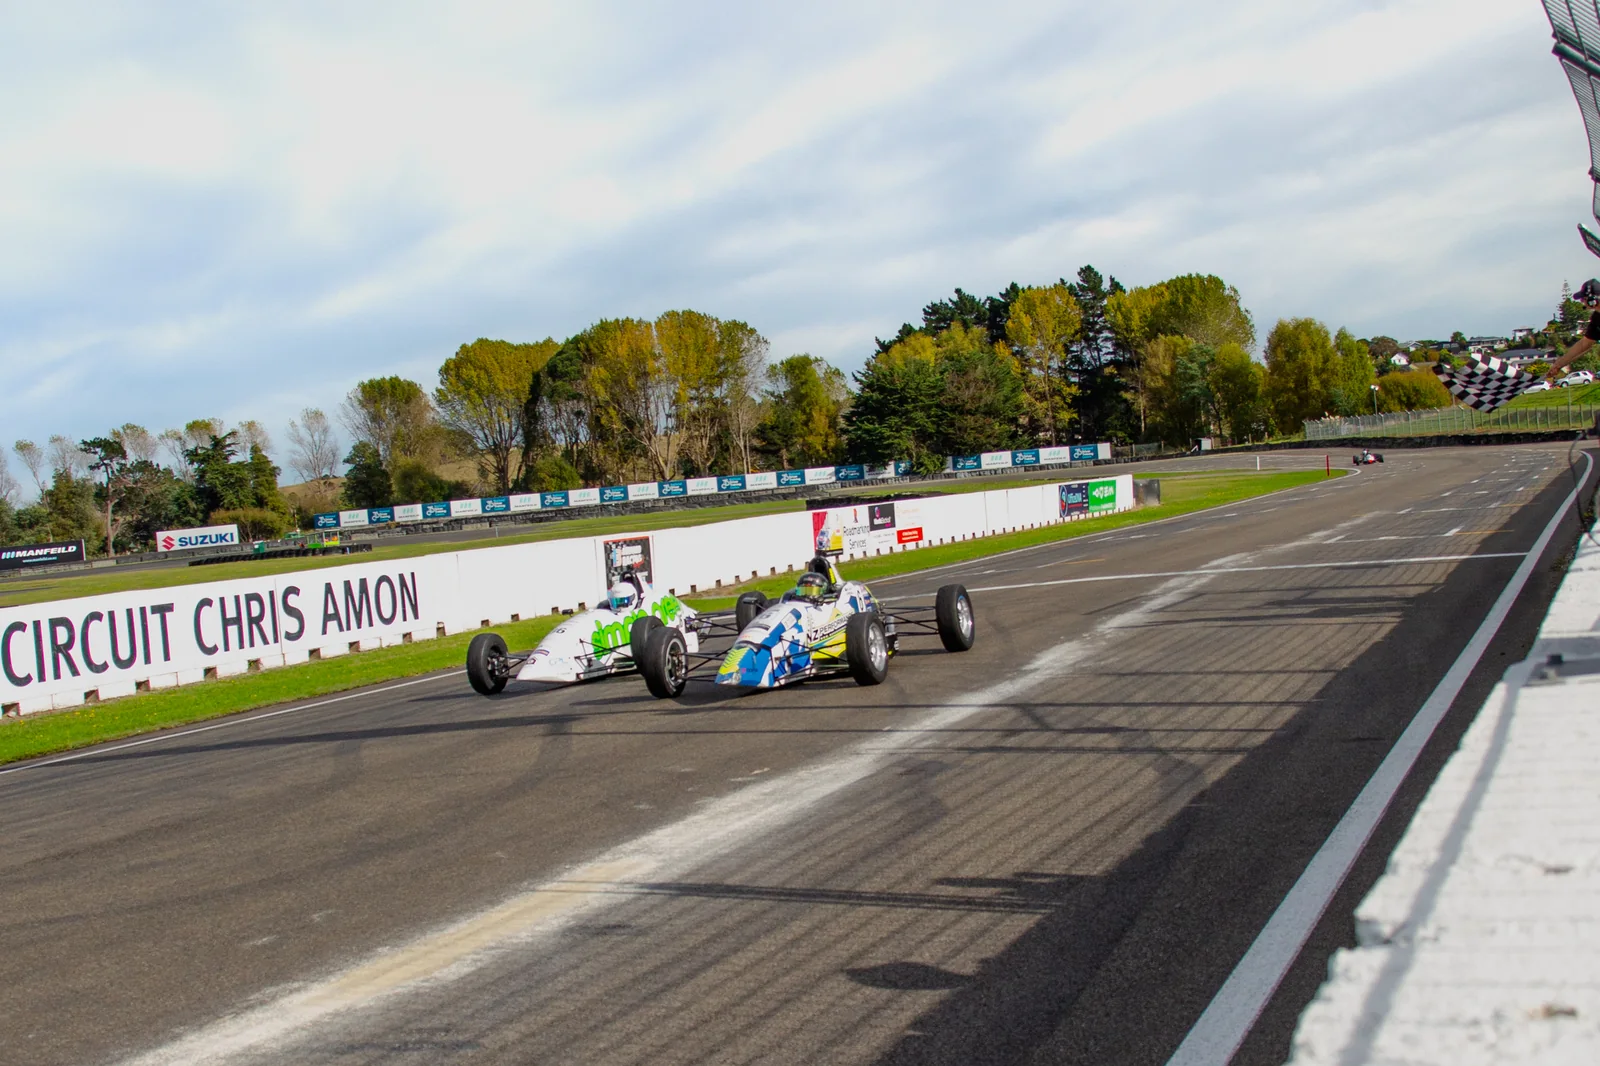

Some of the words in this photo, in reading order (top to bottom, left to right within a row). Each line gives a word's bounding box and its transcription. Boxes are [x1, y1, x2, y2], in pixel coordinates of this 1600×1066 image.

[178, 533, 235, 547] SUZUKI
[15, 545, 77, 558] MANFEILD
[1, 603, 175, 688] CIRCUIT
[193, 586, 306, 656] CHRIS
[321, 572, 420, 636] AMON
